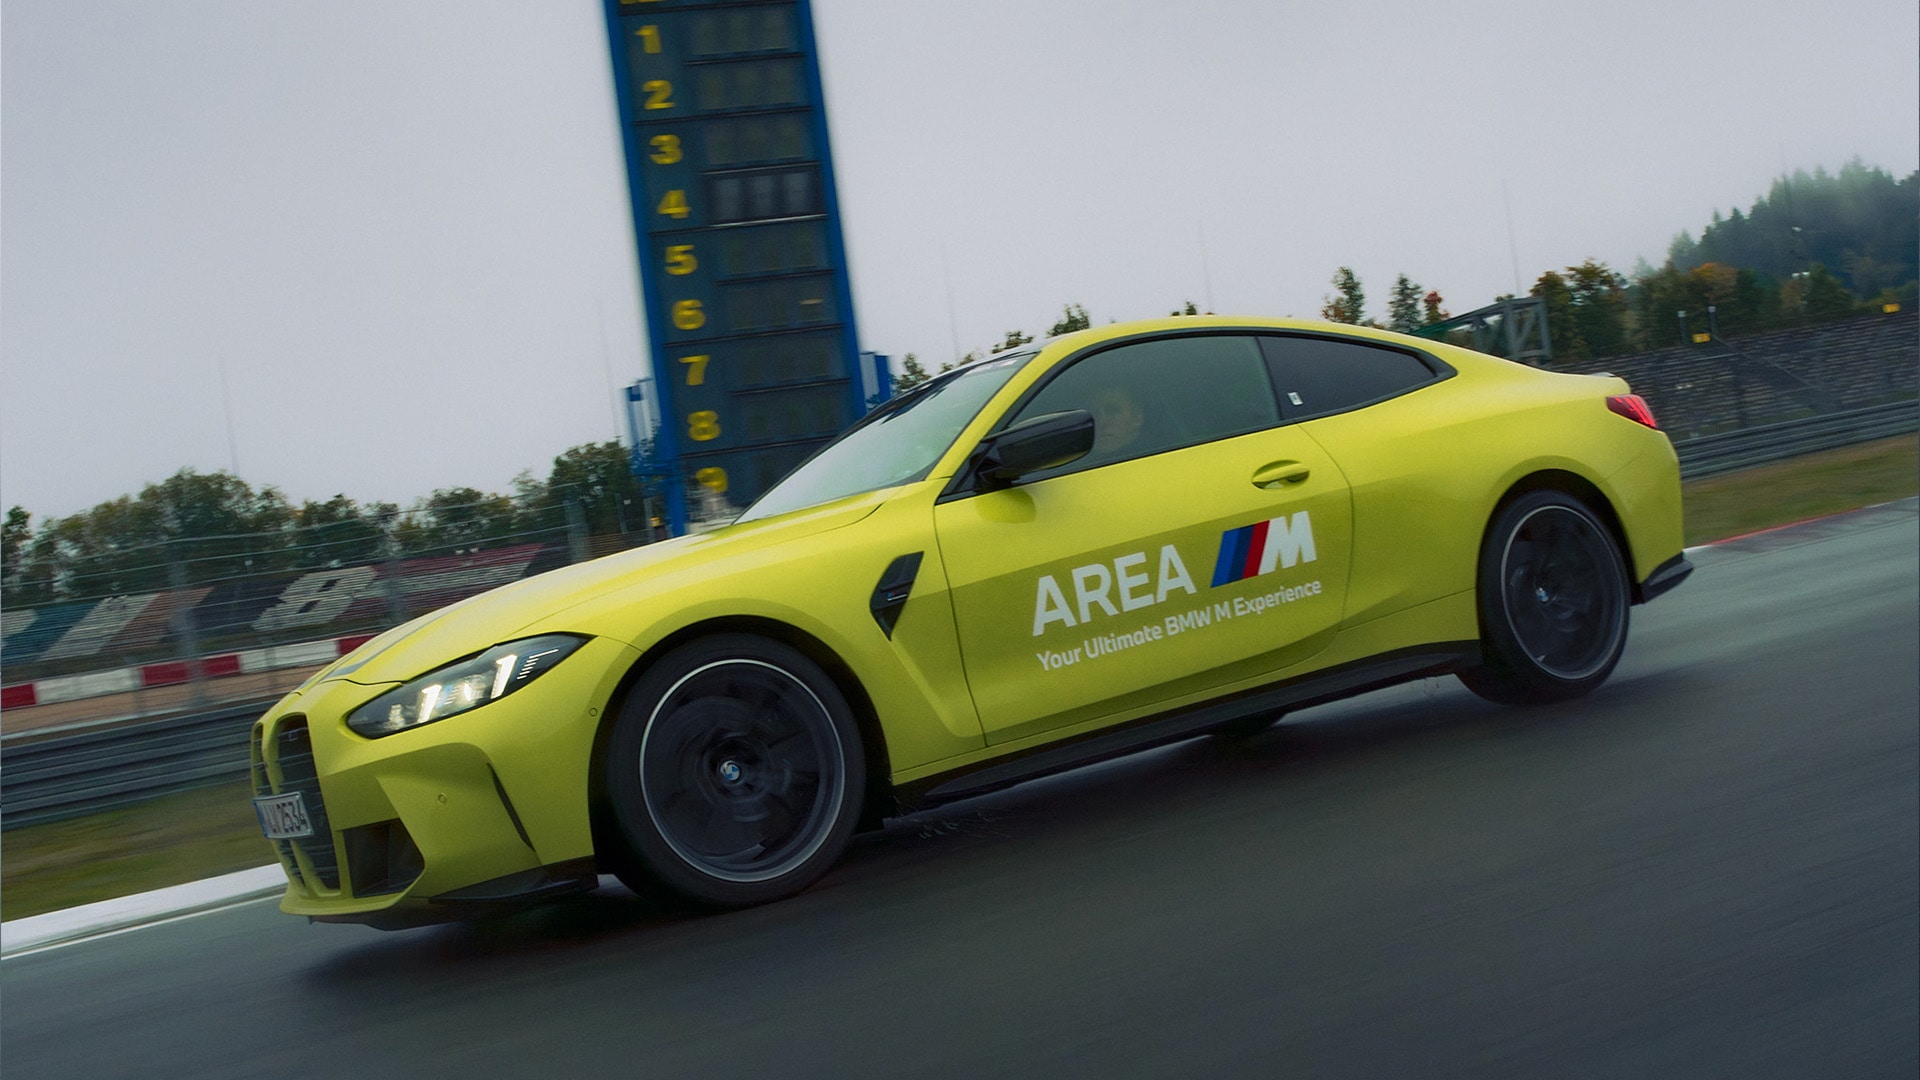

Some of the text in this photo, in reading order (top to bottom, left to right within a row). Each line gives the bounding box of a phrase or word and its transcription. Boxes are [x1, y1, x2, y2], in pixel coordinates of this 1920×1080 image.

[634, 25, 661, 54] 1
[642, 79, 675, 110] 2
[650, 134, 683, 165] 3
[657, 189, 690, 219] 4
[664, 244, 698, 275] 5
[672, 299, 706, 330] 6
[679, 354, 710, 386] 7
[687, 410, 721, 441] 8
[696, 466, 728, 493] 9
[1032, 510, 1317, 637] AREA M
[1036, 580, 1322, 671] Your Ultimate BMW M Experience
